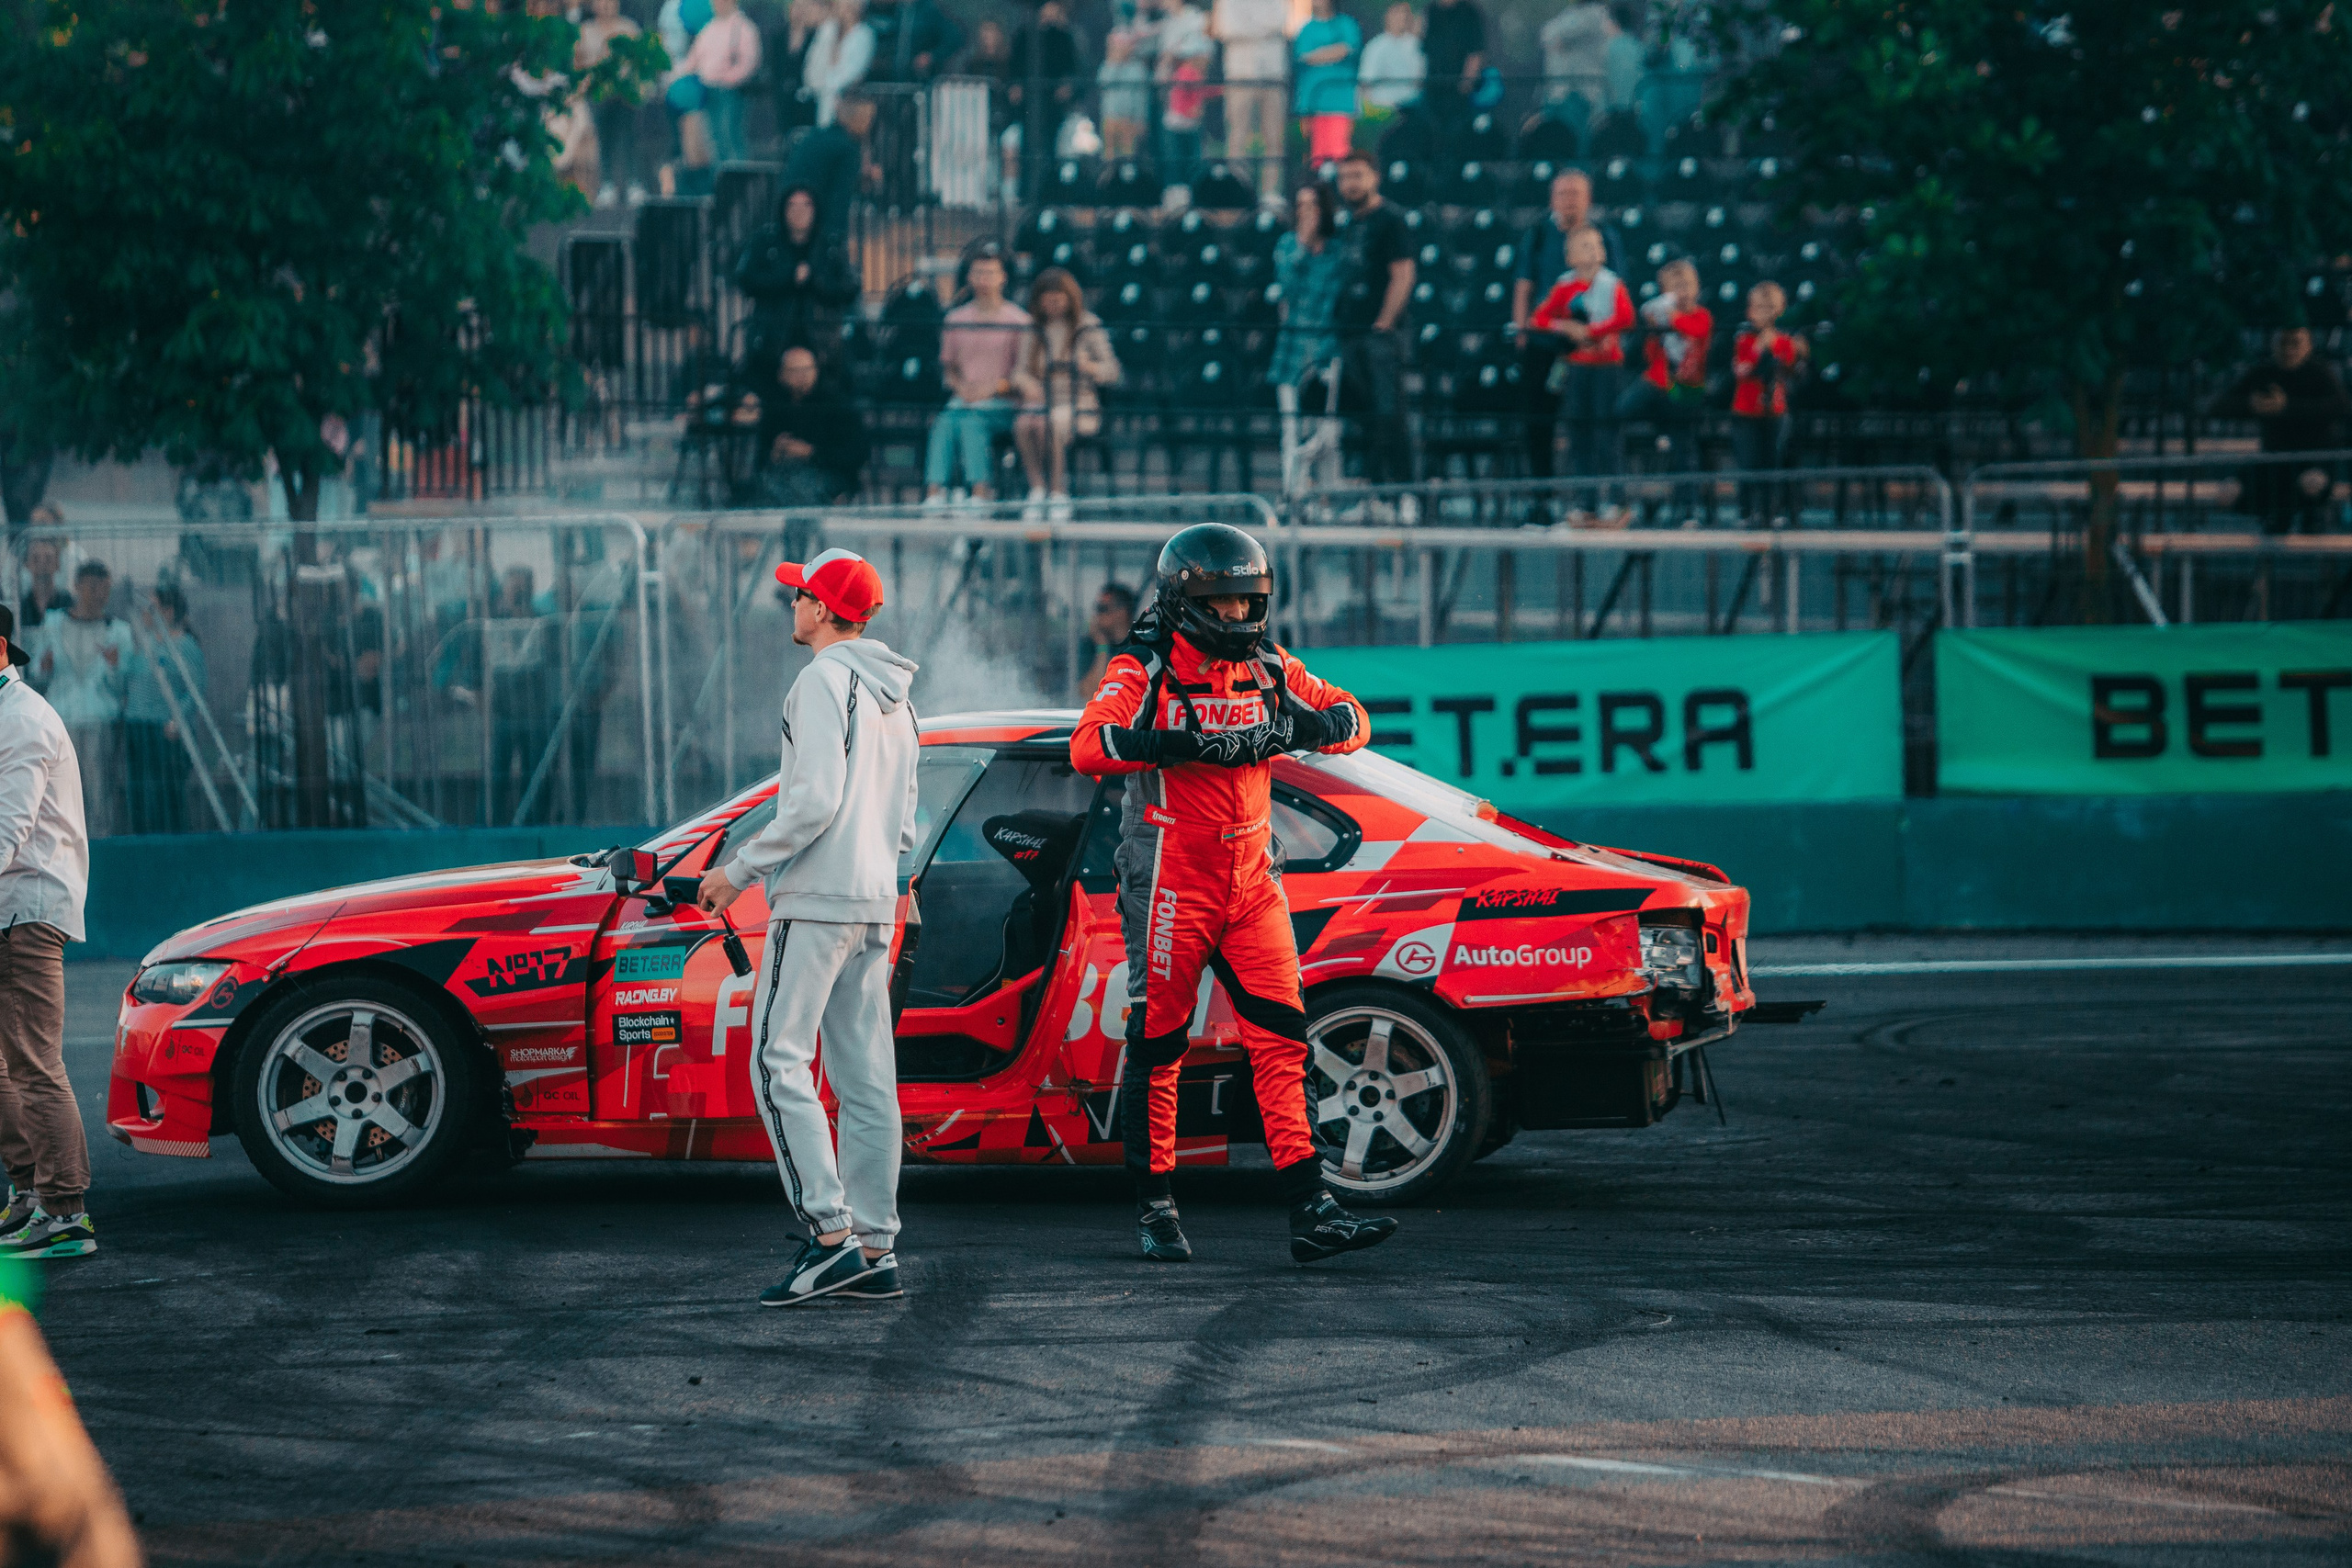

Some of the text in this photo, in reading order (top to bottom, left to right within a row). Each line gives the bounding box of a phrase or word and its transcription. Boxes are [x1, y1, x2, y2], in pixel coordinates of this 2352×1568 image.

[1173, 701, 1265, 728] FONBET
[1152, 810, 1176, 825] freem
[993, 827, 1047, 849] KAPSHAI
[1476, 887, 1562, 908] KAPSHAI
[1152, 886, 1177, 981] FONBET
[1453, 944, 1592, 970] AutoGroup
[618, 1015, 670, 1029] Blockchain
[619, 1029, 650, 1043] Sports
[510, 1047, 567, 1056] SHOPMARKA
